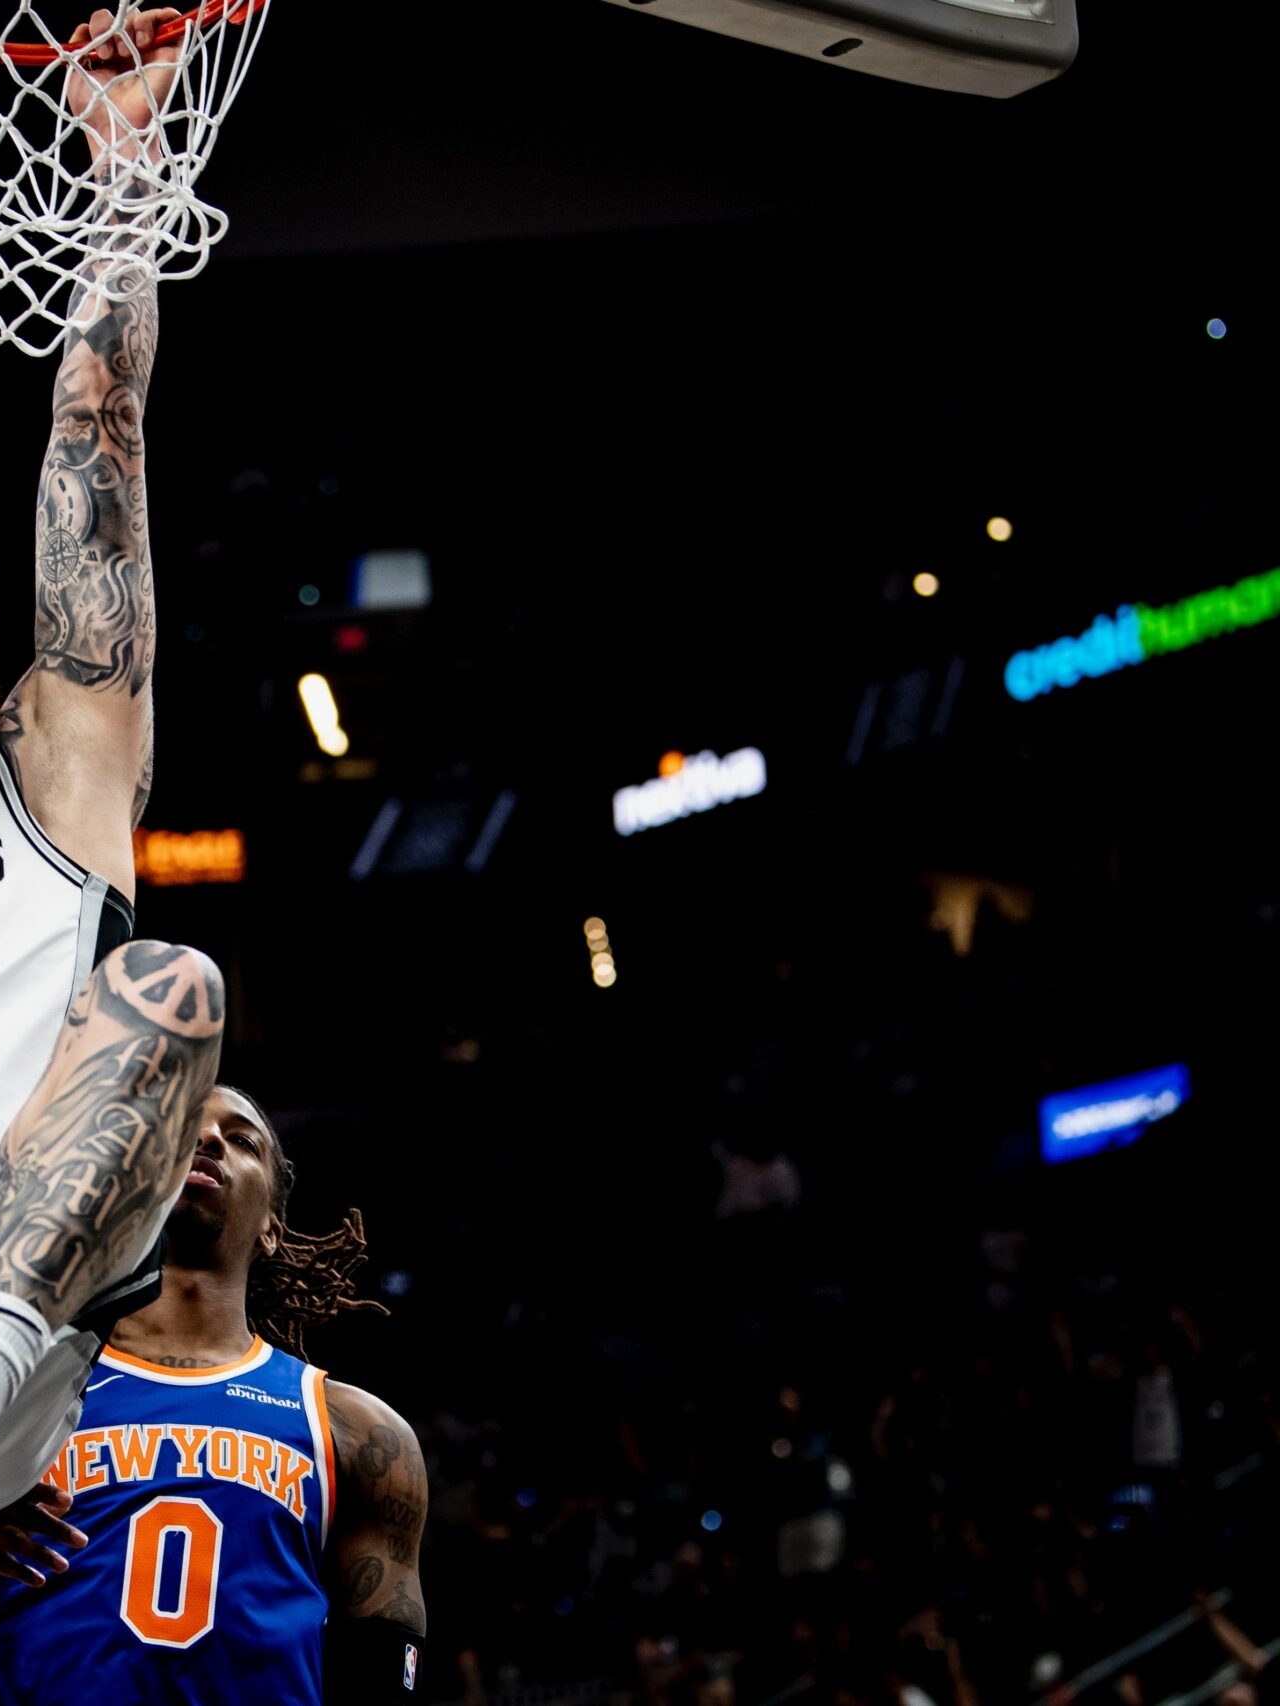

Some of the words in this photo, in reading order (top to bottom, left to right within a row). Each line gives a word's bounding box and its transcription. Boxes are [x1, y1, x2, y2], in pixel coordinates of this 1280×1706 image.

[225, 1387, 256, 1401] abu
[257, 1393, 301, 1410] dhabi
[166, 1424, 314, 1524] YORK
[120, 1495, 224, 1650] 0
